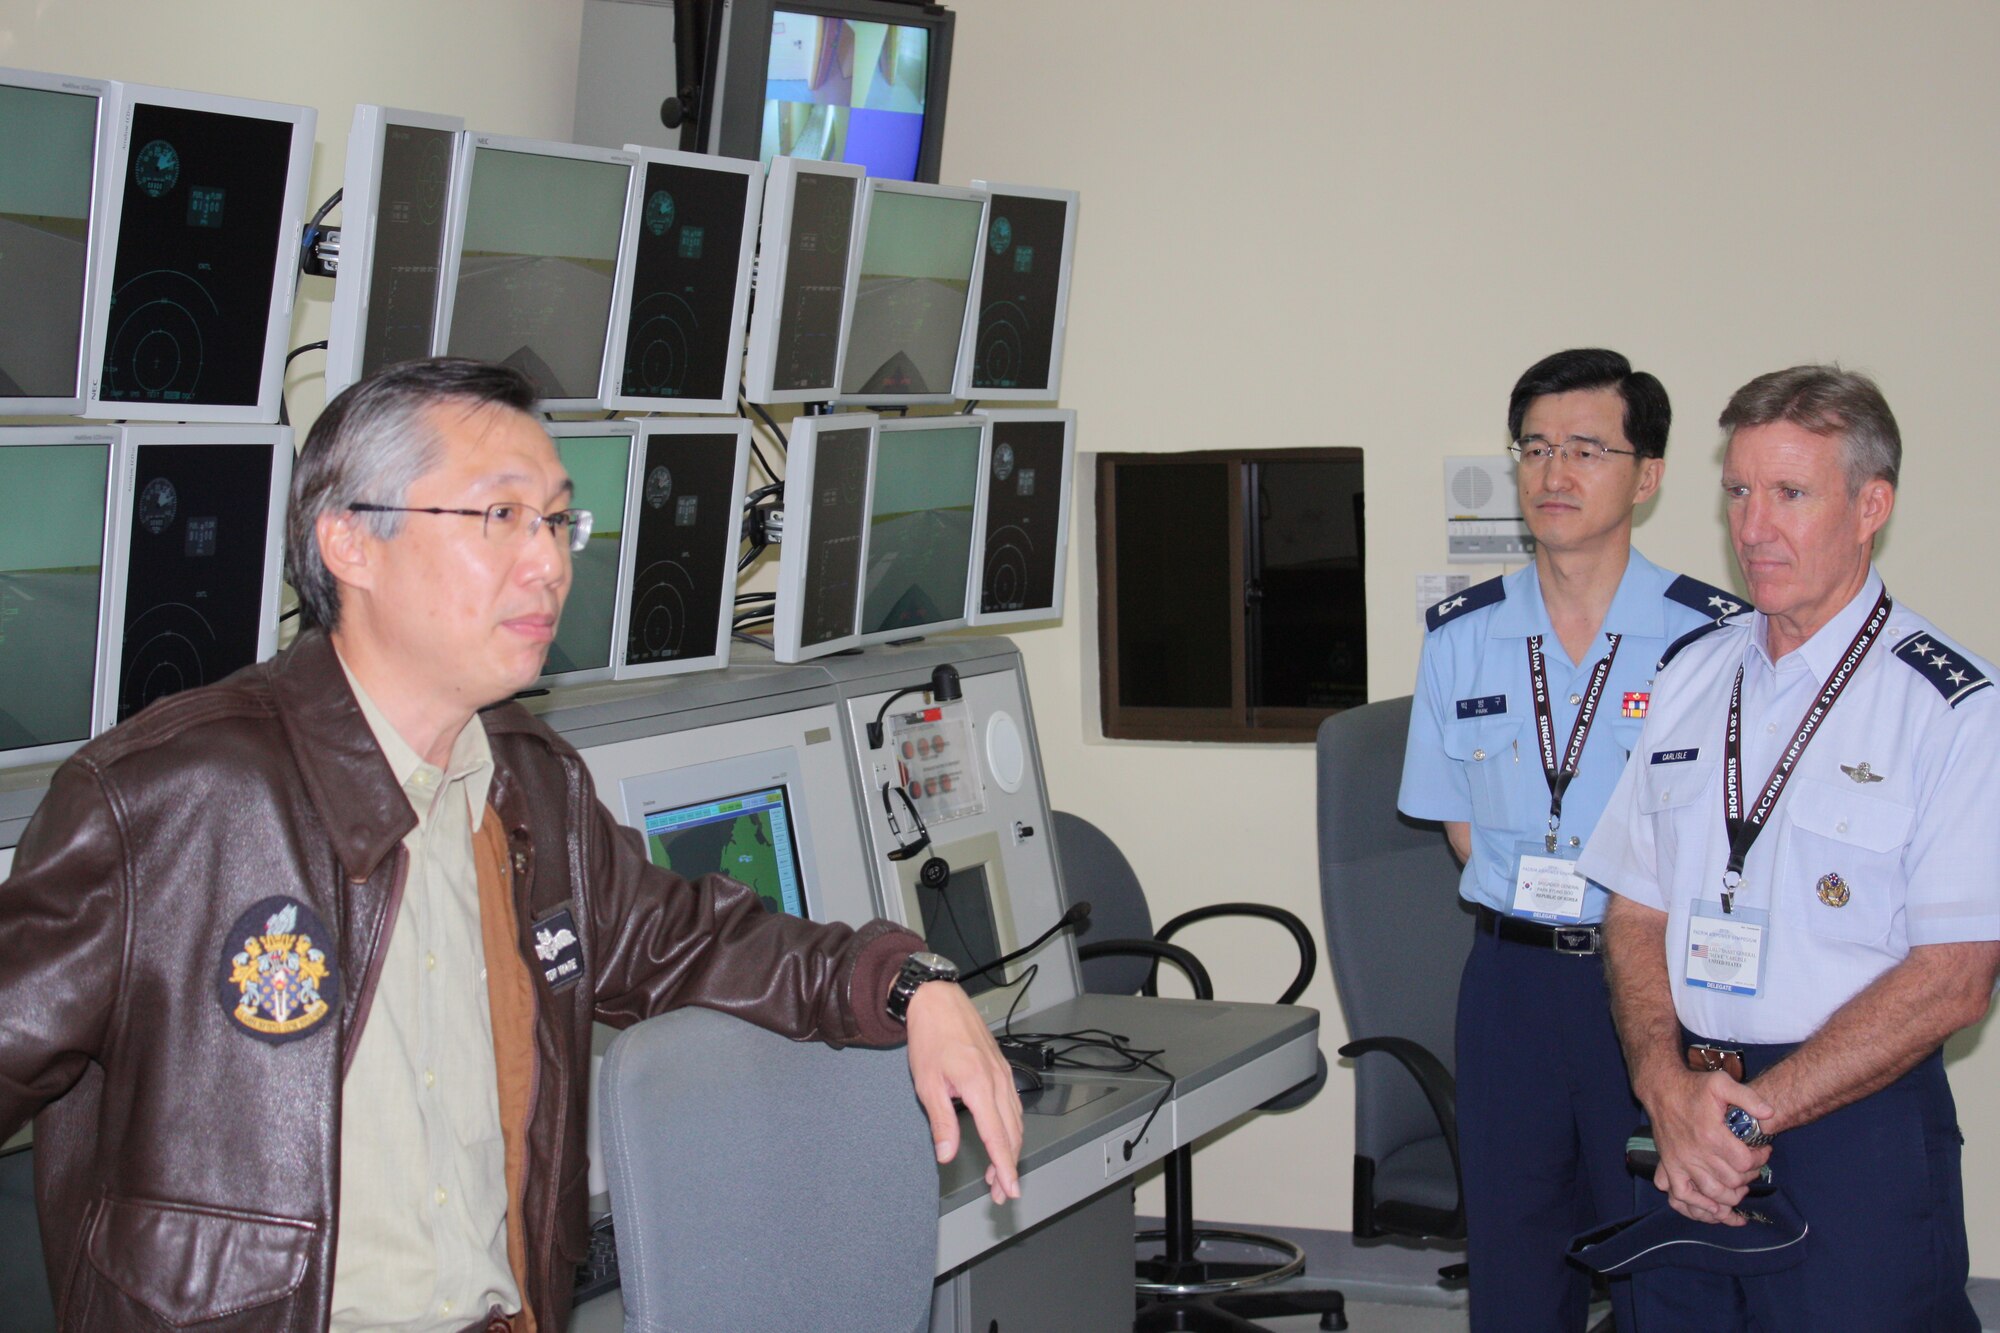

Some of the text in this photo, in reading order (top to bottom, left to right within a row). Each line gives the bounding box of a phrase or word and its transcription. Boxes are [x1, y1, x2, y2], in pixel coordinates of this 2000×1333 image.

[1535, 674, 1545, 702] 2010
[1540, 715, 1554, 770] SINGAPORE
[1566, 664, 1607, 771] PACRIM AIRPOWER
[1729, 713, 1737, 742] 2010
[1753, 607, 1887, 825] PACRIM AIRPOWER SYMPOSIUM 2010
[1662, 752, 1687, 761] CARLISLE
[1728, 758, 1738, 819] SINGAPORE
[1707, 982, 1732, 991] DELEGATE
